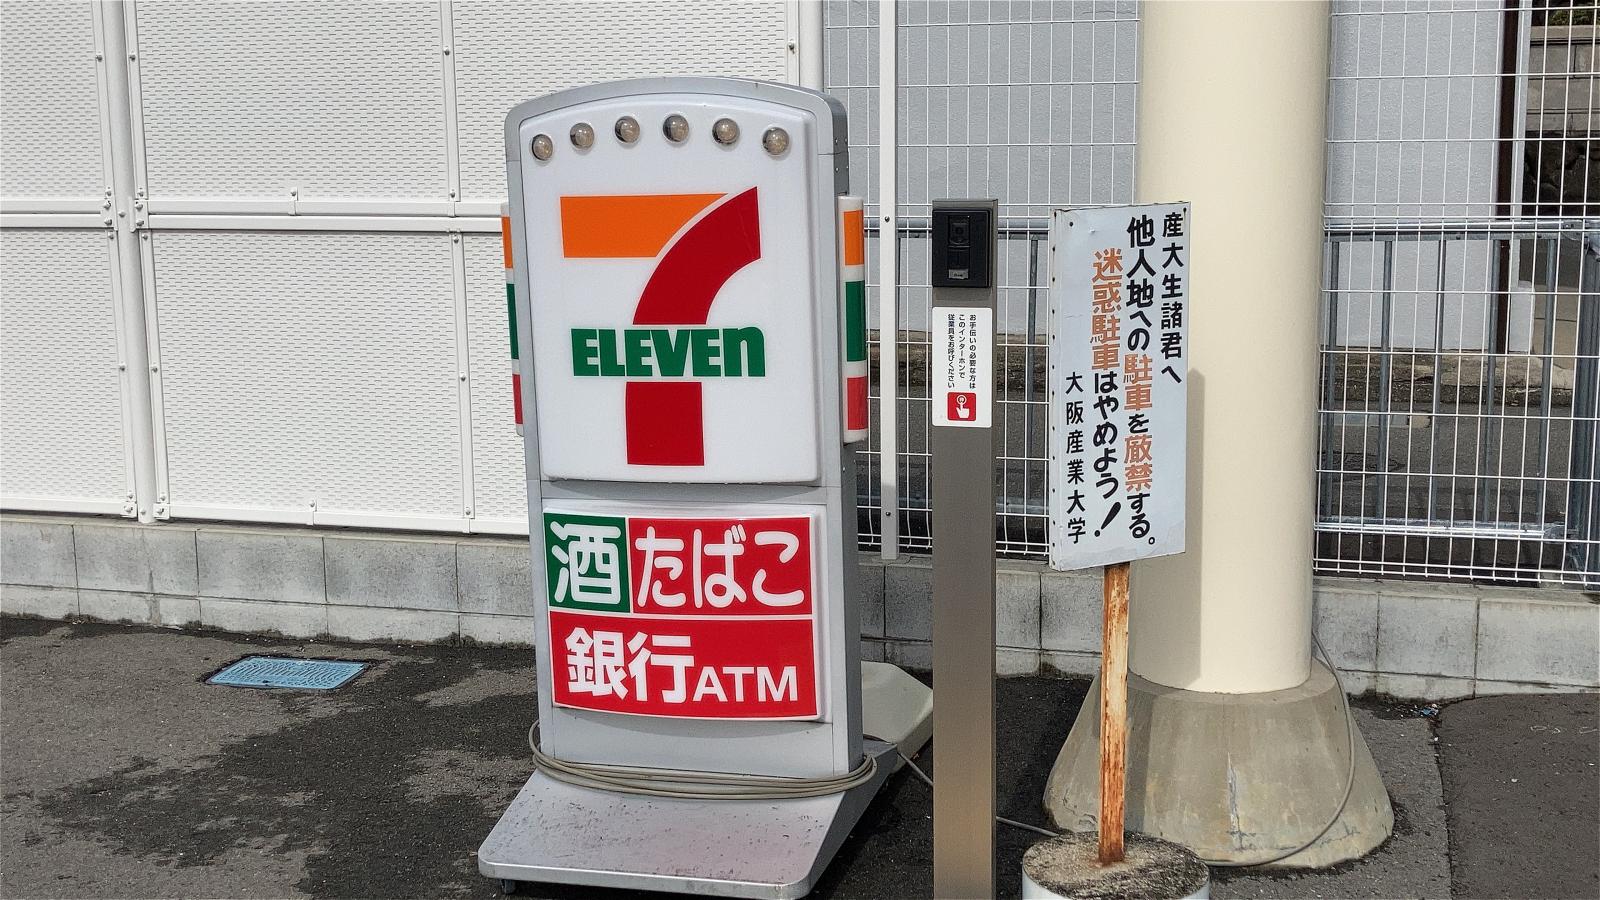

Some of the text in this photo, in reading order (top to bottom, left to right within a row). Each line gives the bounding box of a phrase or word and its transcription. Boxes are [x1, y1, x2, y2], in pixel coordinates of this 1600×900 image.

[560, 186, 761, 466] 7
[947, 313, 955, 389] 従業員をお呼びください
[958, 314, 966, 379] このインターホンで
[969, 314, 977, 389] お手伝いの必要な方は
[1160, 212, 1184, 384] 産大生諸君へ
[1123, 214, 1156, 545] 他人地への駐車を厳禁する。
[1065, 371, 1086, 544] 大阪産業大学
[550, 521, 805, 609] 酒 たばこ
